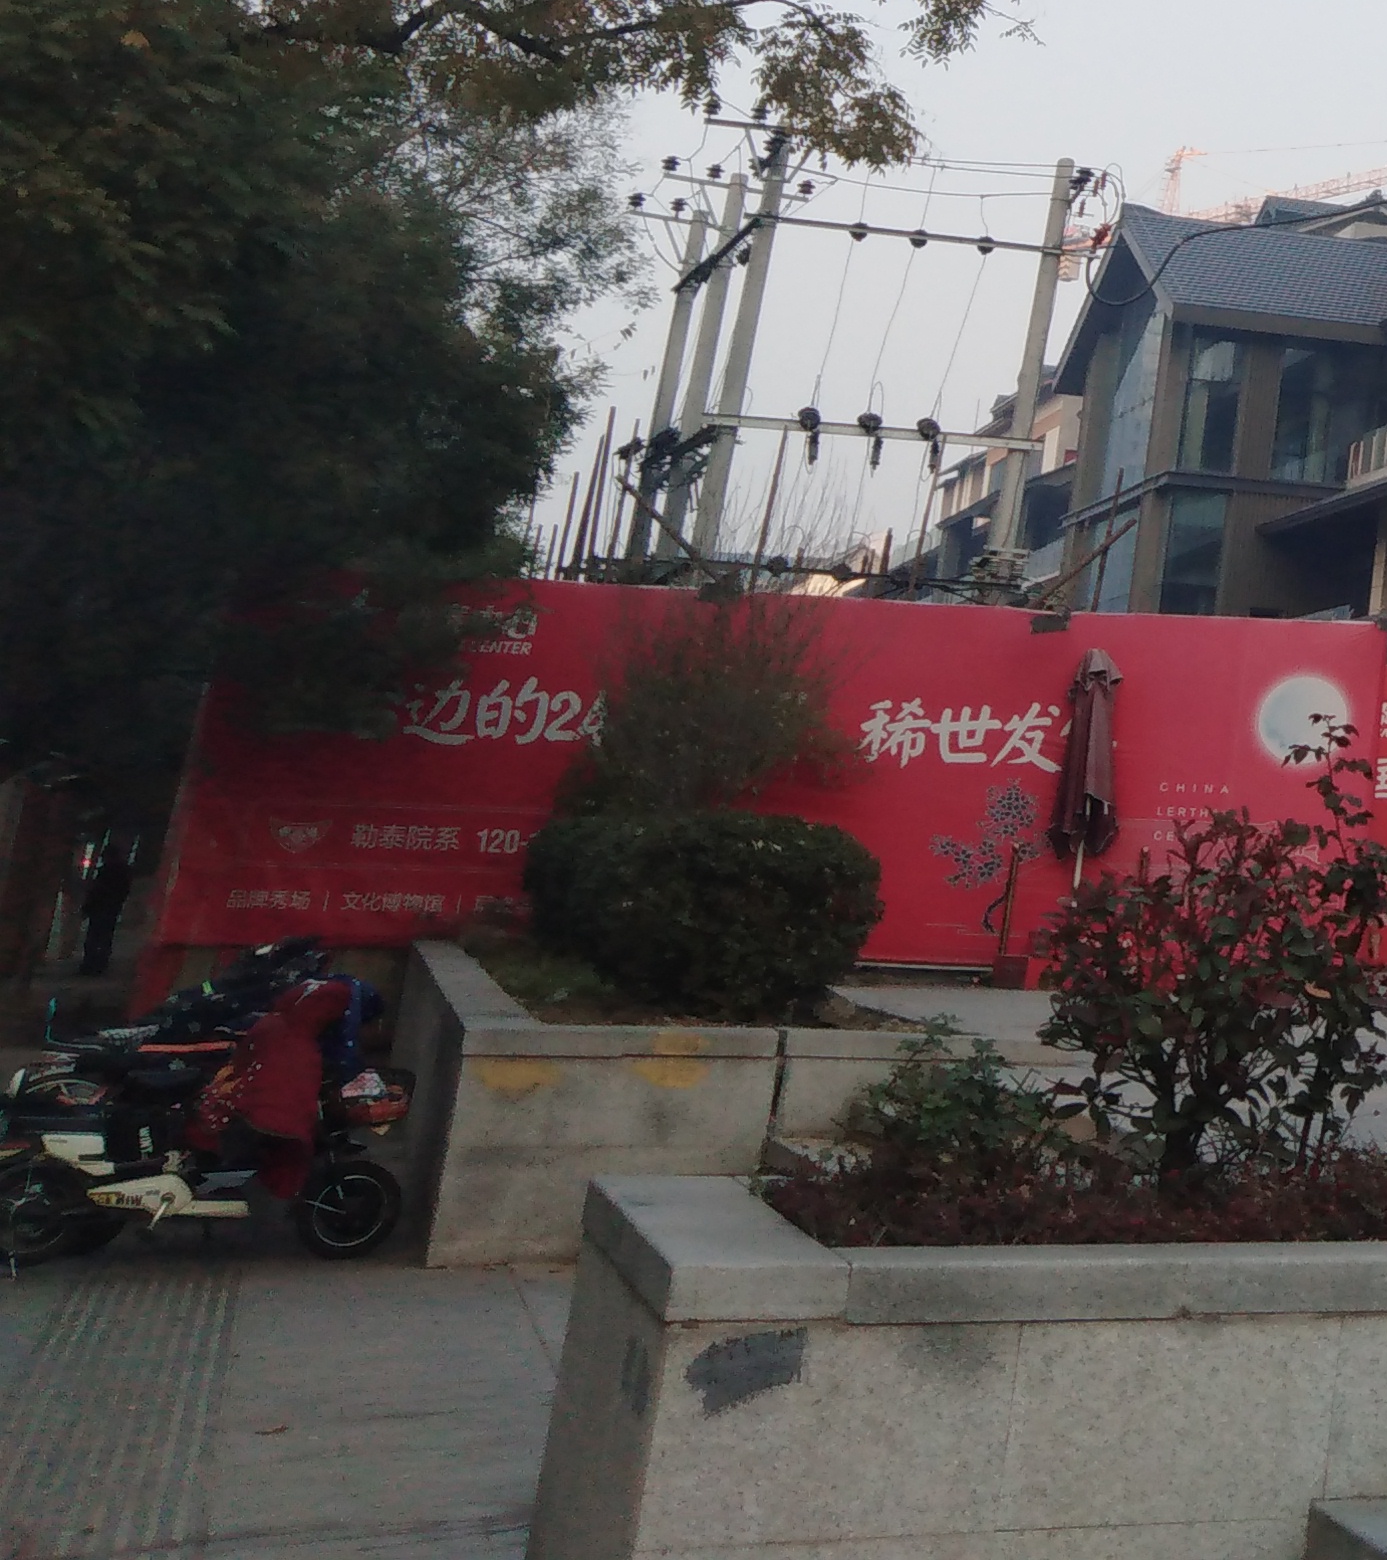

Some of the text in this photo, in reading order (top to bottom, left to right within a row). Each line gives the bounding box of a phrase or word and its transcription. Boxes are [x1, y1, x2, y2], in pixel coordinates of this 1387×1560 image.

[857, 697, 1072, 773] 稀世发
[1159, 782, 1230, 794] CHINA
[1156, 807, 1227, 818] LERTH
